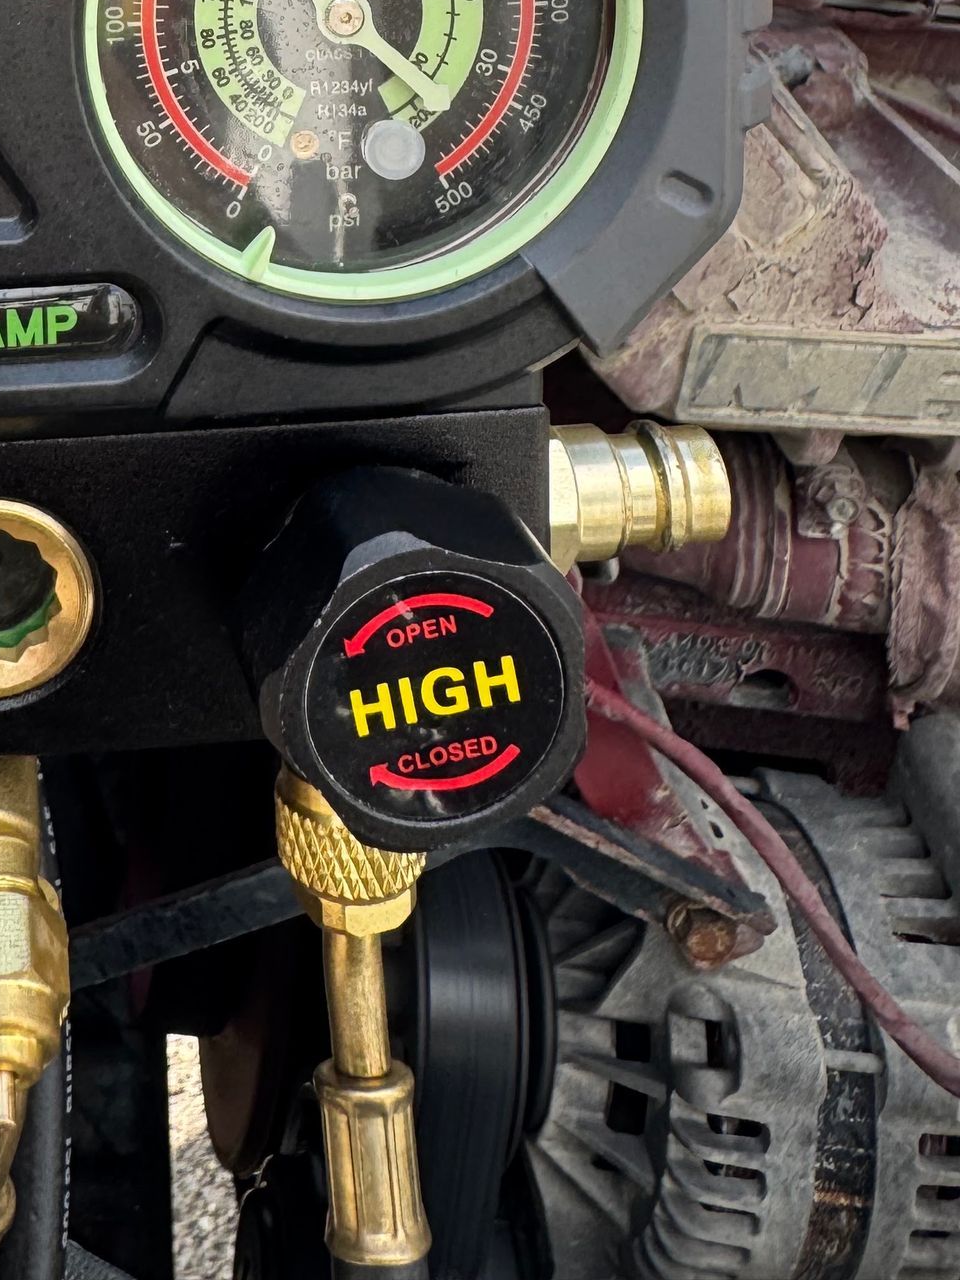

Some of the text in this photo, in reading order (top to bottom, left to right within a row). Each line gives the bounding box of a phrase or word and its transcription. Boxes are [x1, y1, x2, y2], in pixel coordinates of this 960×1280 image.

[105, 6, 124, 44] 100
[200, 28, 216, 49] 80
[239, 19, 255, 40] 80
[180, 59, 200, 74] 5
[476, 48, 498, 77] 30
[520, 94, 547, 135] 450
[136, 120, 163, 148] 50
[257, 144, 272, 162] 0
[325, 161, 361, 180] bar
[226, 201, 241, 218] 0
[434, 182, 473, 214] 500
[328, 209, 361, 233] psi
[385, 615, 458, 649] OPEN
[349, 655, 521, 738] HIGH
[397, 736, 498, 773] CLOSED
